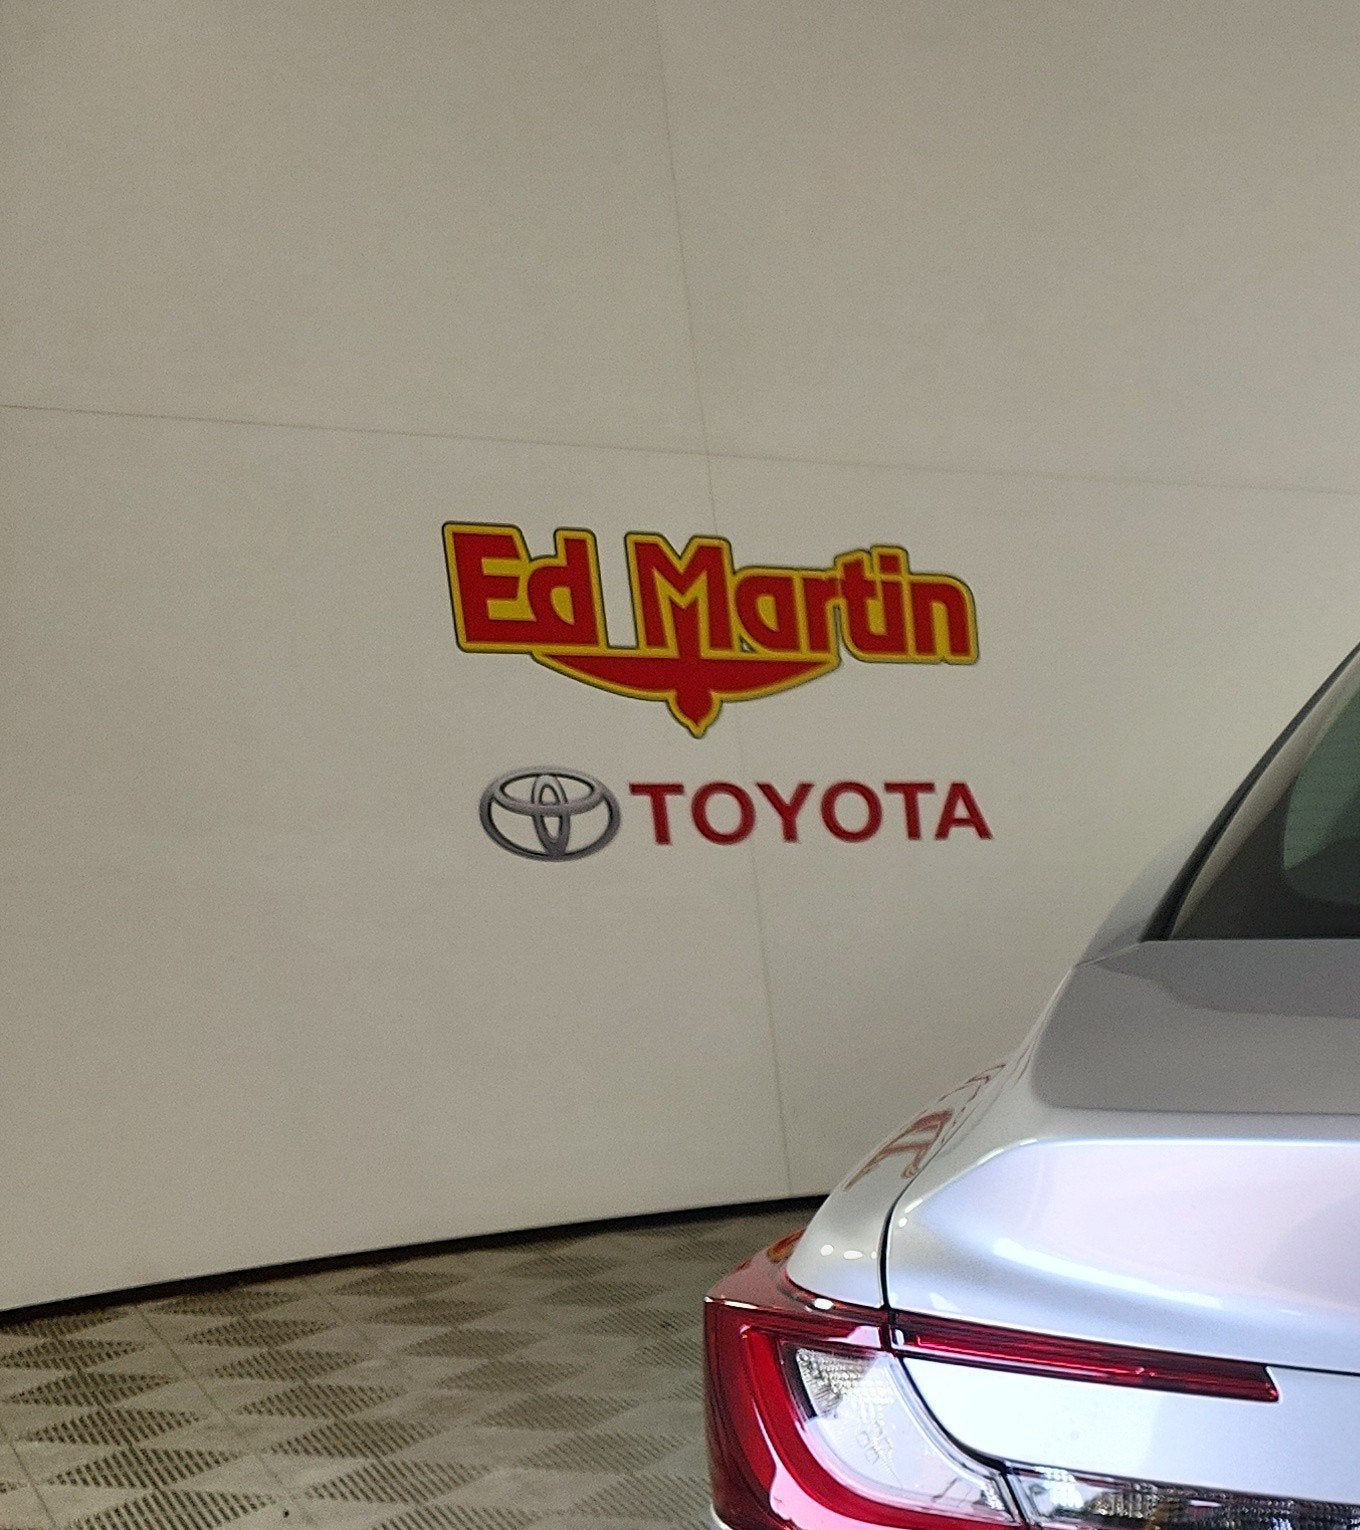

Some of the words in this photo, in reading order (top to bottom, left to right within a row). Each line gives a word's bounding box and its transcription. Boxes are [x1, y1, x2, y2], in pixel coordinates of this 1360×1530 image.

[444, 523, 604, 650] Ed
[626, 533, 978, 663] Martin
[630, 780, 993, 846] TOYOTA
